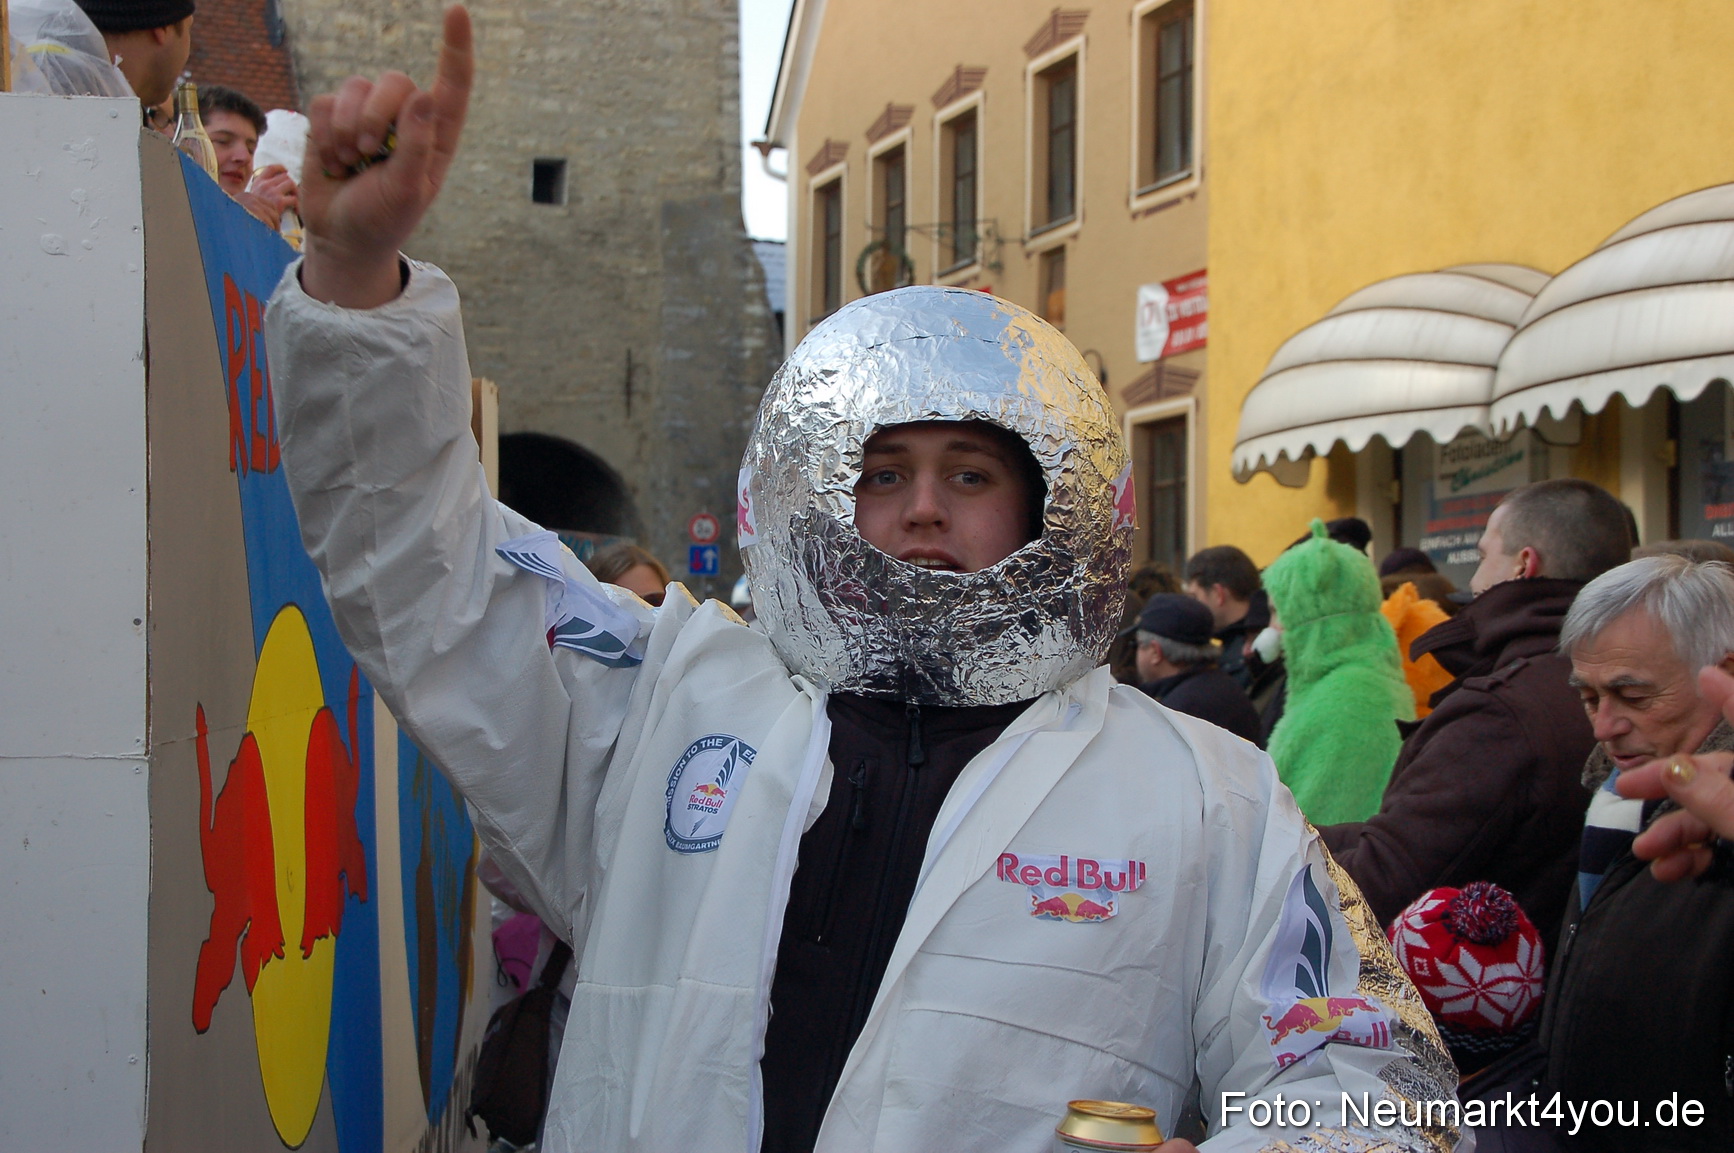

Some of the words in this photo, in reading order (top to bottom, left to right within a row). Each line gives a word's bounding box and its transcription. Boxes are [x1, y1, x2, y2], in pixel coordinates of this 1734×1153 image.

[686, 745, 698, 759] TO
[700, 738, 724, 749] THE
[687, 803, 719, 815] STRATOS
[689, 794, 706, 805] Red
[705, 797, 723, 808] Bull
[997, 852, 1069, 887] Red
[1076, 858, 1146, 892] Bull
